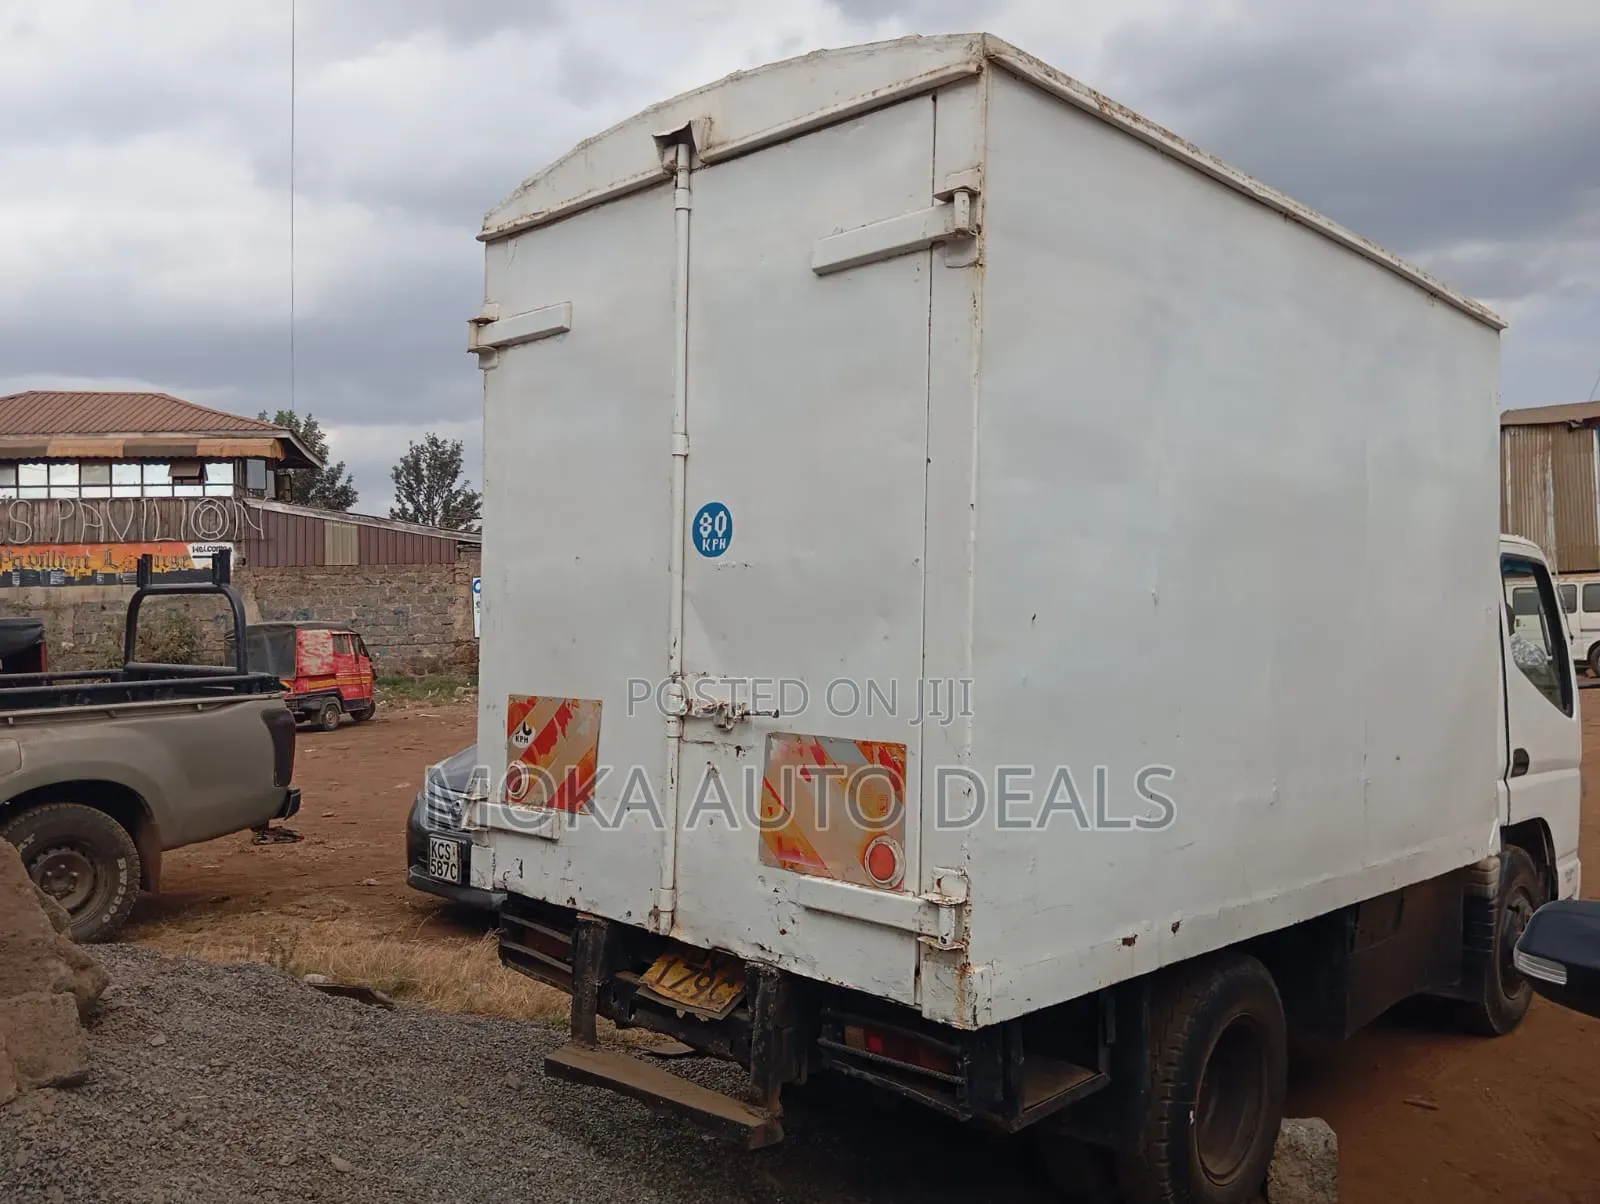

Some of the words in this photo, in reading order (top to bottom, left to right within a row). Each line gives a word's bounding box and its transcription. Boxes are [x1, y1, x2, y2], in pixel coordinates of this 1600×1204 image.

[56, 496, 268, 544] PAVILION
[699, 511, 728, 538] 80
[702, 538, 726, 551] KPH
[515, 735, 529, 744] KPH
[431, 840, 451, 860] KCS
[430, 859, 457, 880] 587C
